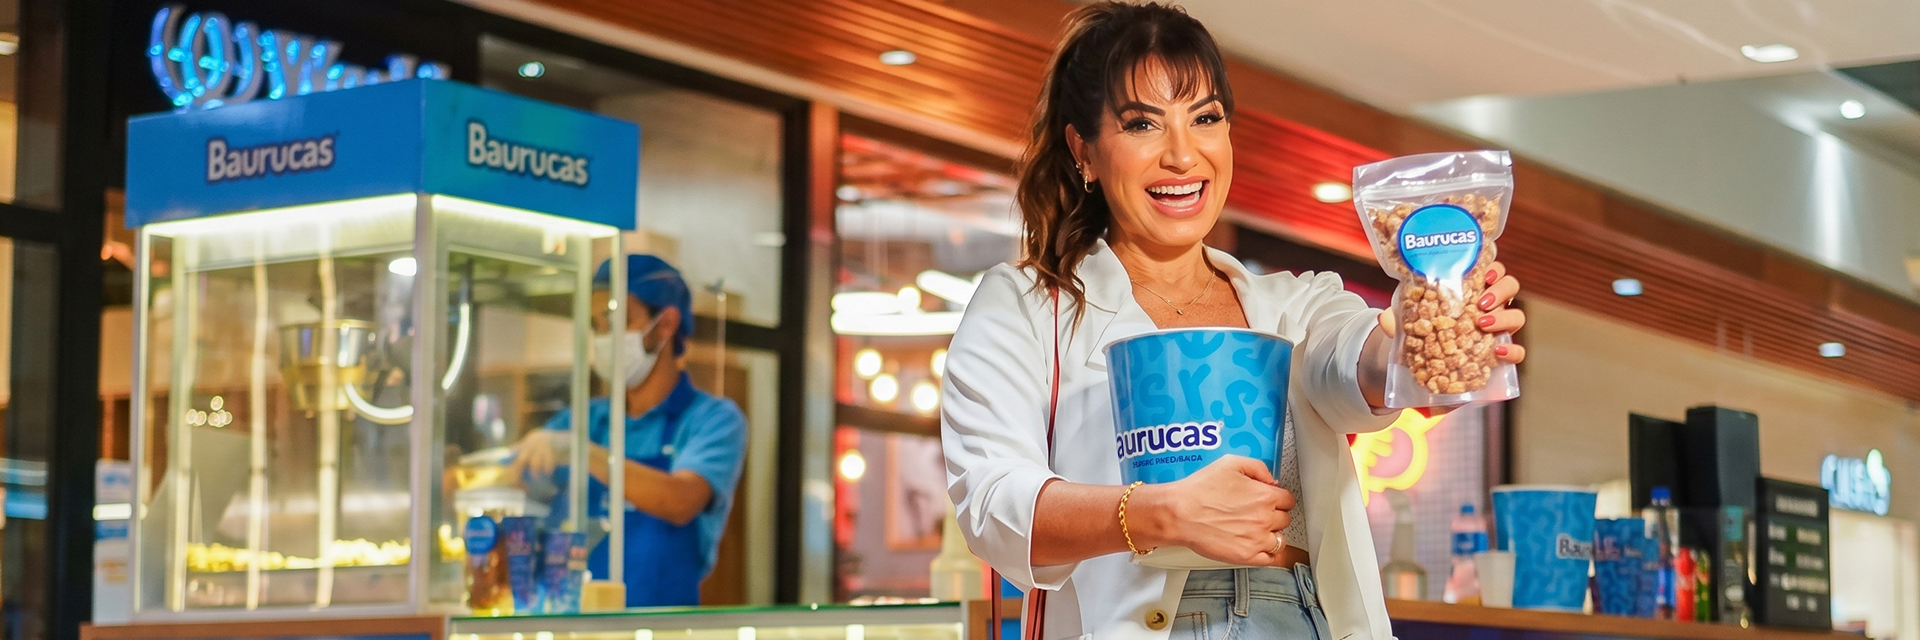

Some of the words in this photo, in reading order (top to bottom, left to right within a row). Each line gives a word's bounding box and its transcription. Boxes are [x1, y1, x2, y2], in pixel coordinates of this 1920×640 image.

[207, 137, 334, 182] Baurucas
[466, 120, 588, 185] Baurucas
[1405, 230, 1476, 250] Baurucas
[1116, 424, 1219, 459] aurucas
